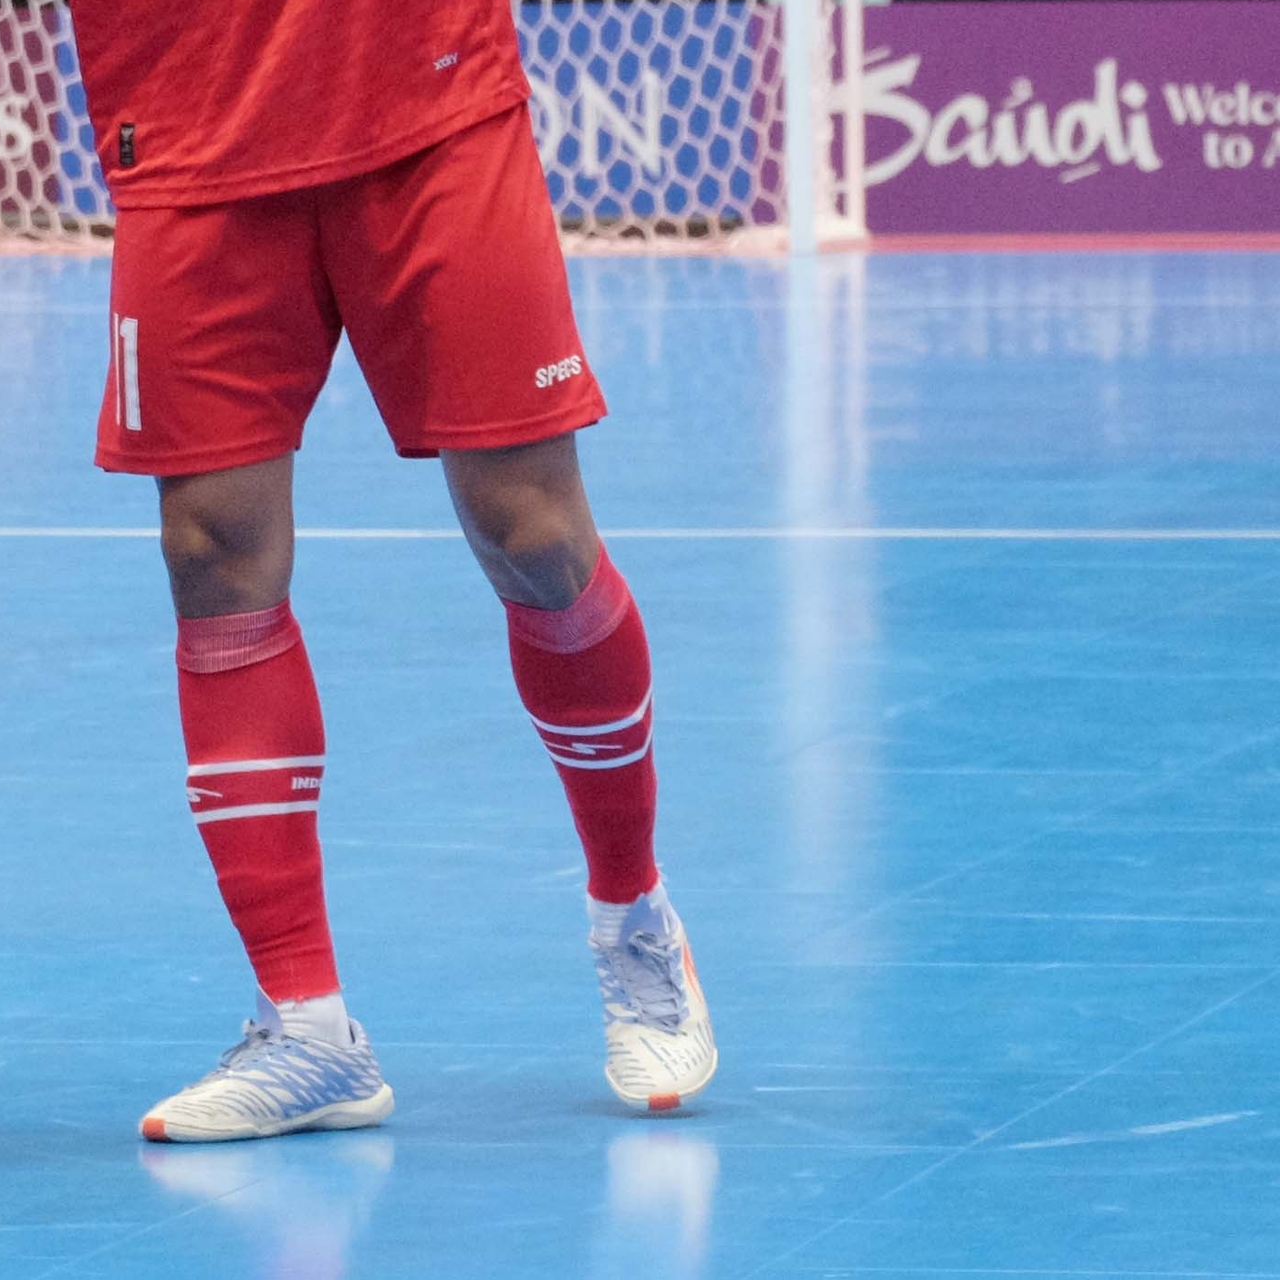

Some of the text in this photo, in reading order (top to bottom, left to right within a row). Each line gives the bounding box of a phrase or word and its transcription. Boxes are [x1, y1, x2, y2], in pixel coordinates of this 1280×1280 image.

[1162, 81, 1280, 127] Welc
[1202, 131, 1254, 169] to
[535, 354, 583, 389] SPECS
